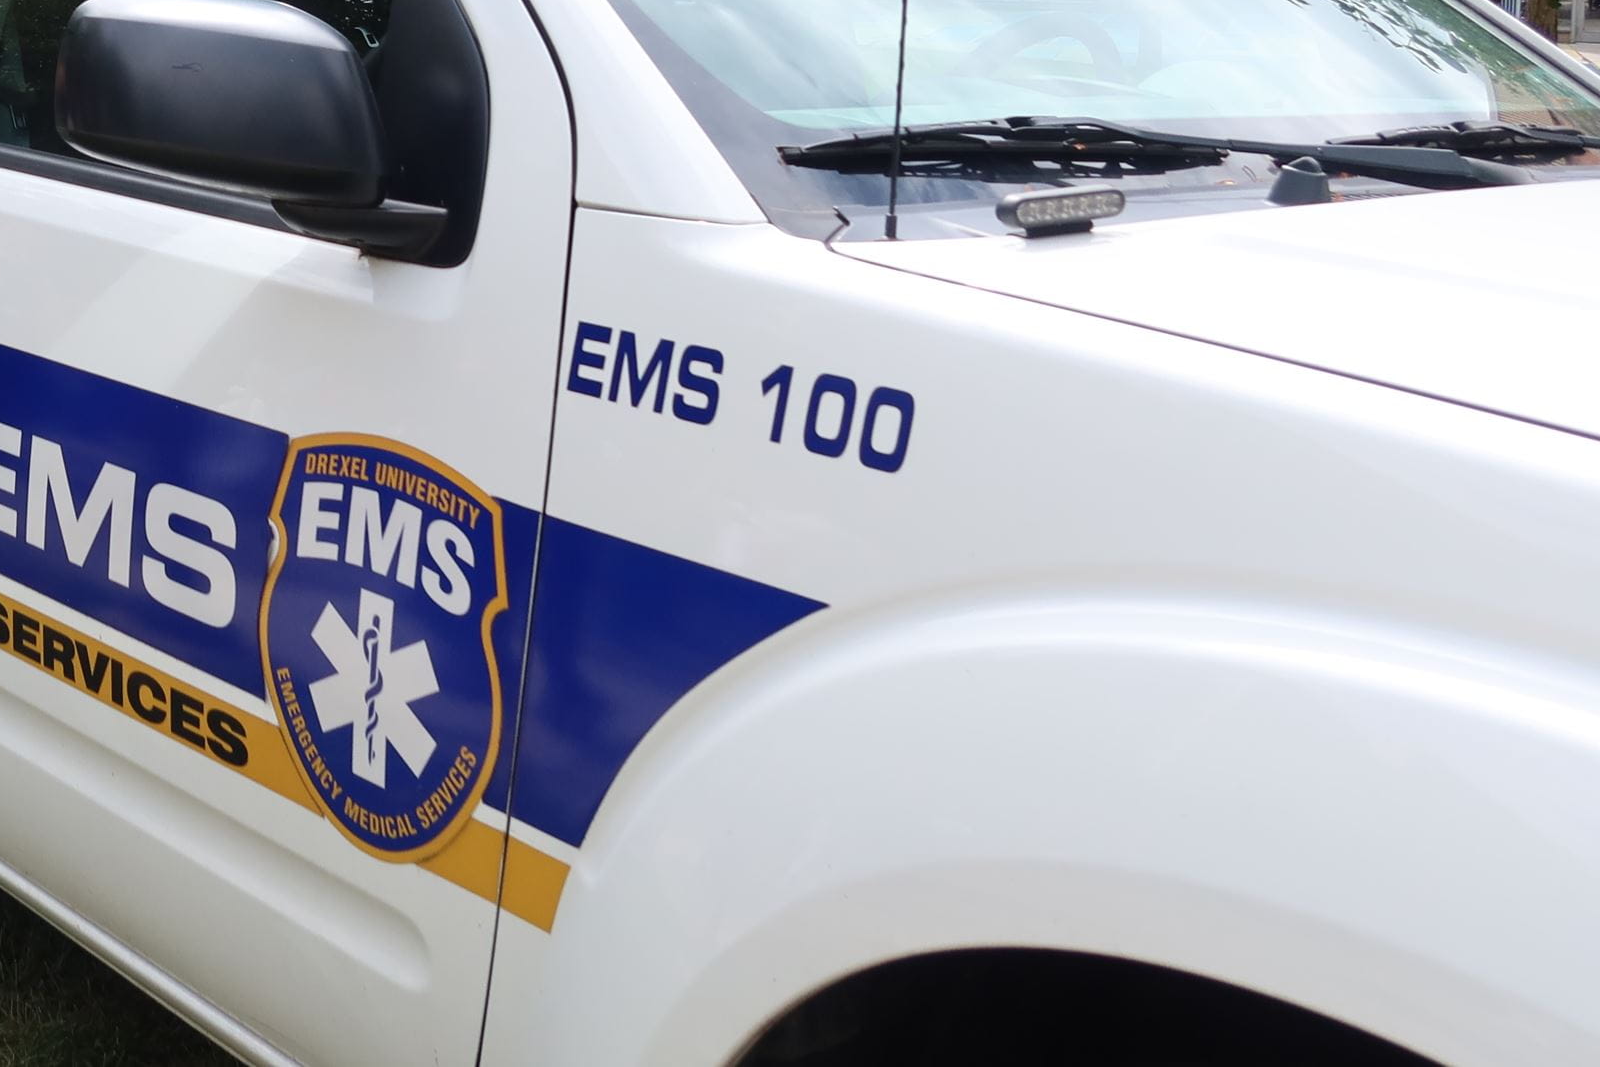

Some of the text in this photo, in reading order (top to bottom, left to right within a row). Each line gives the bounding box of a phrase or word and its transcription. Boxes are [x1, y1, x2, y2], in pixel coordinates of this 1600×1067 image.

[566, 320, 915, 474] EMS 100
[296, 481, 475, 617] EMS
[304, 453, 481, 530] DREXEL UNIVERSITY
[276, 667, 478, 839] EMERGENCY MEDICAL SERVICES
